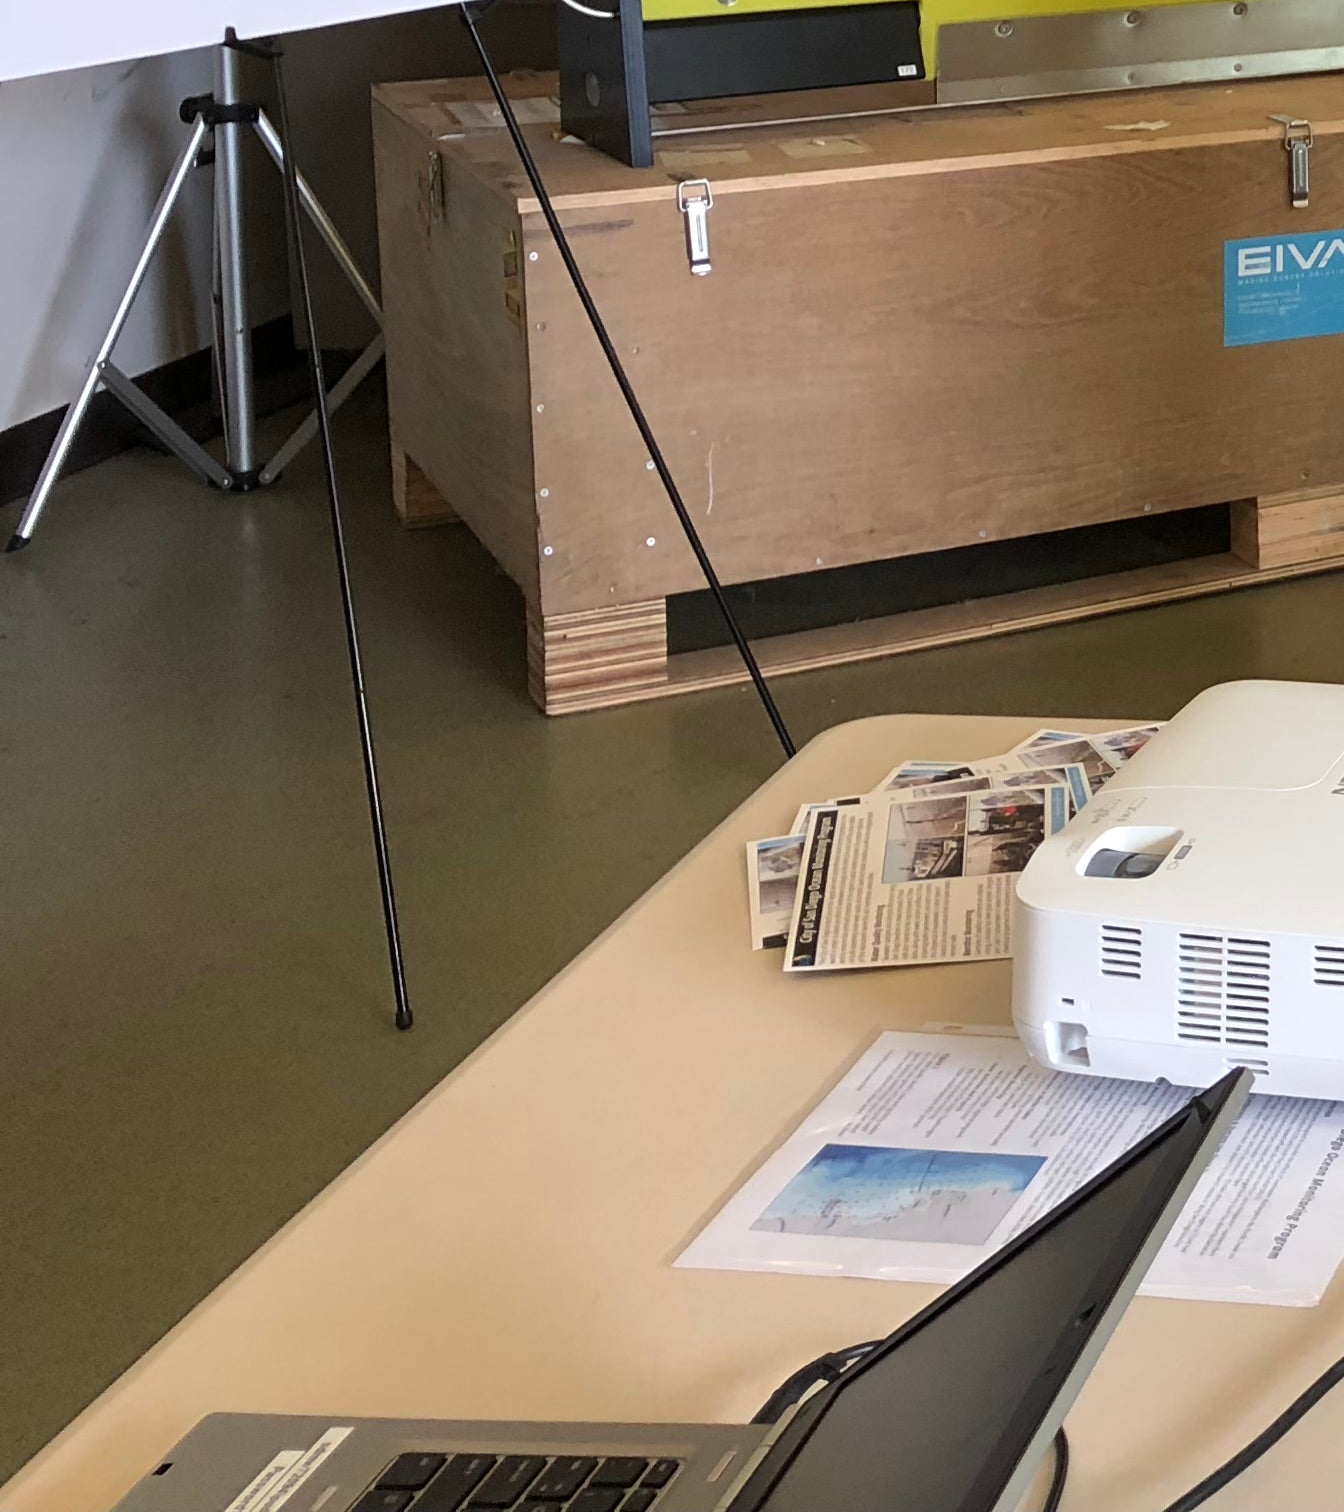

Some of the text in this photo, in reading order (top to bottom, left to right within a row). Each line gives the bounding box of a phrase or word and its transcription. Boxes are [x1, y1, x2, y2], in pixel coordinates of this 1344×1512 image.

[1316, 1152, 1338, 1177] Ocean
[1286, 1177, 1325, 1222] Monitoring
[1267, 1223, 1298, 1260] Program
